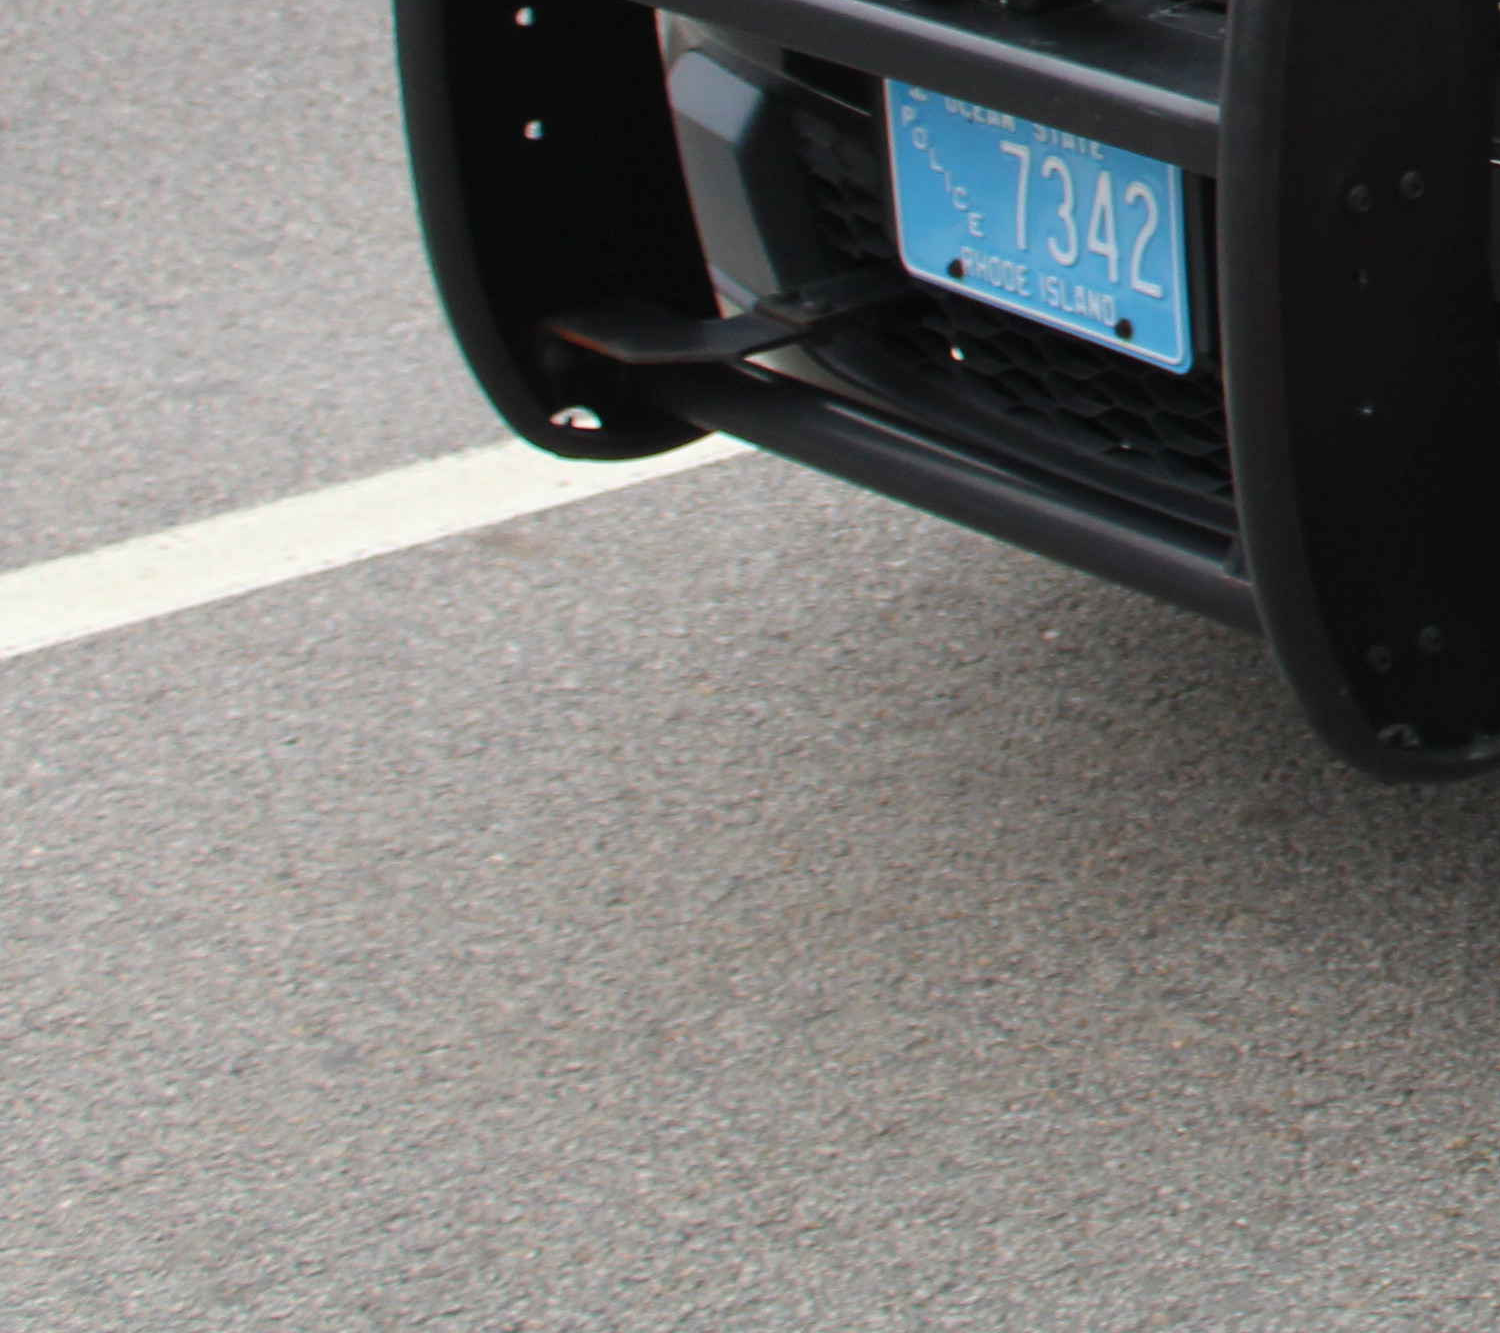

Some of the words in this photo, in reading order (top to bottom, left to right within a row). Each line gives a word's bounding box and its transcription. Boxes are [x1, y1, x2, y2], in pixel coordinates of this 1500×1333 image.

[900, 105, 985, 239] POLICE
[999, 139, 1164, 300] 7342
[961, 245, 1032, 298] RHODE
[1038, 273, 1117, 328] ISLAND
